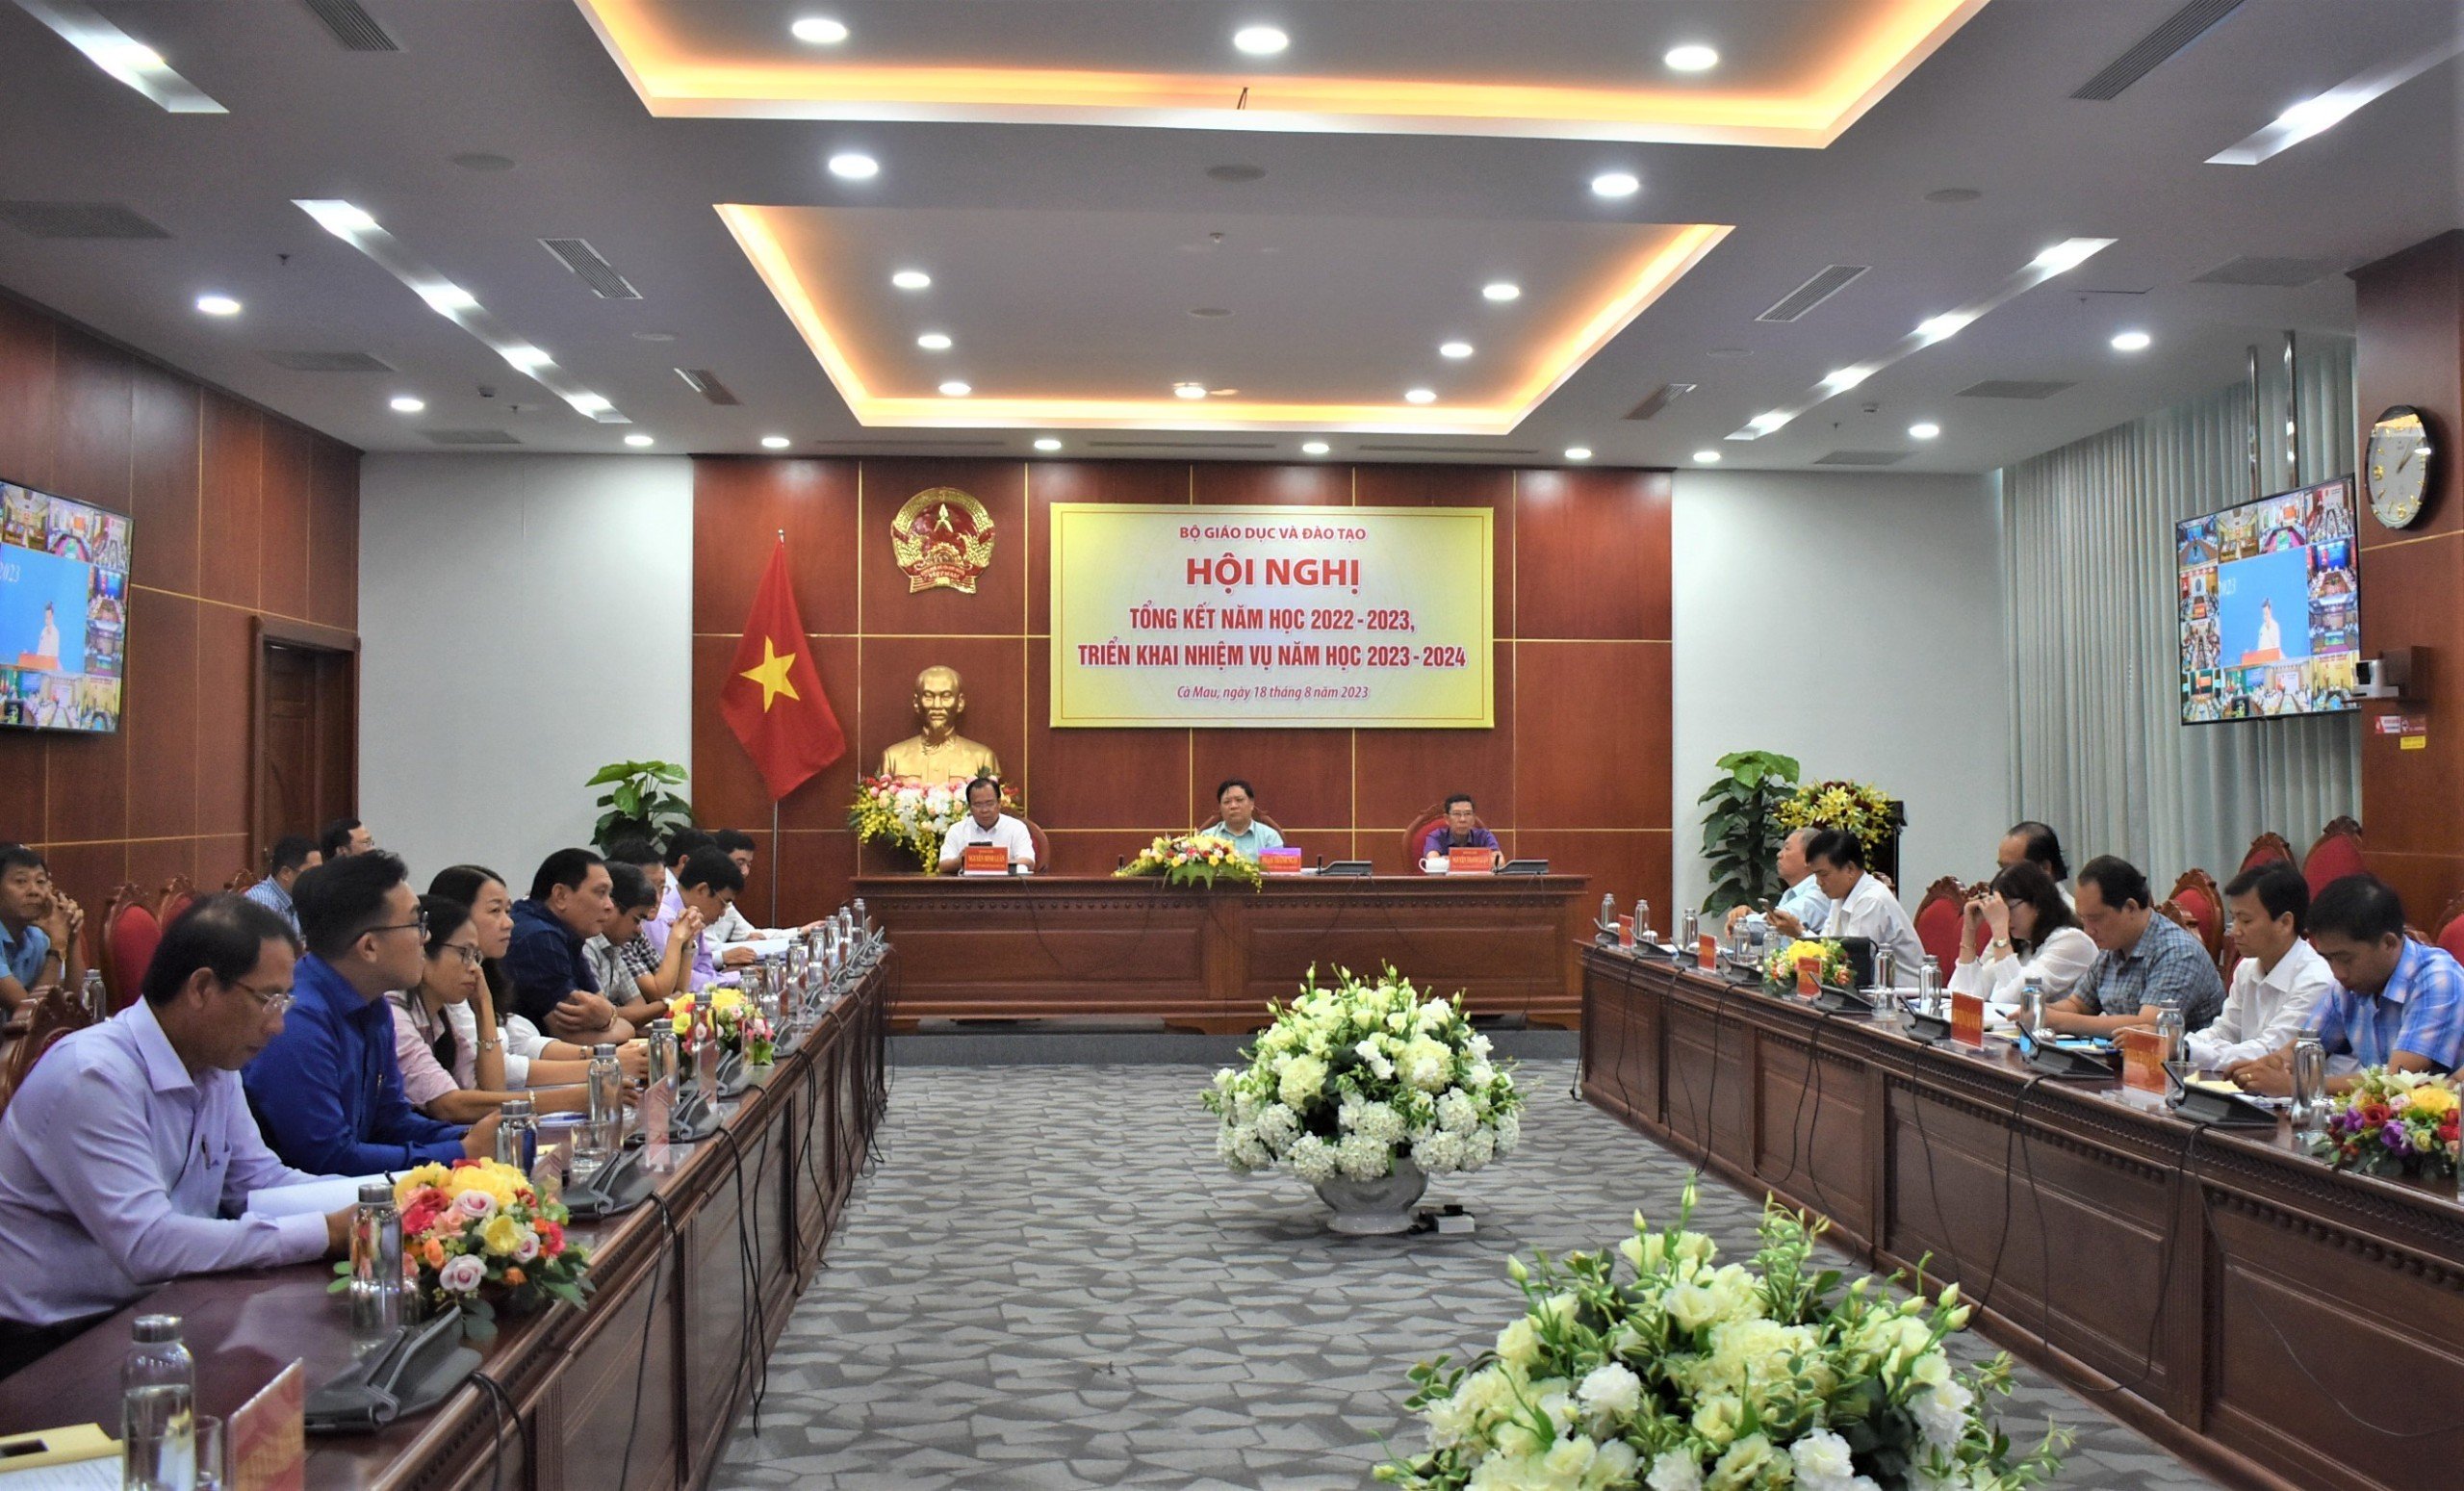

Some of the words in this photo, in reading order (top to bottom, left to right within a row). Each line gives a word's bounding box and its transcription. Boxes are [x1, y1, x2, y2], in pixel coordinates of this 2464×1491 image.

[1179, 525, 1201, 542] BỘ
[1204, 525, 1242, 539] GIÁO
[1245, 527, 1275, 543] DỤC
[1279, 525, 1298, 539] VÀ
[1302, 526, 1334, 540] ĐÀO
[1337, 528, 1366, 543] TẠO
[1187, 552, 1253, 595] HỘI
[1266, 558, 1359, 595] NGHỊ
[1130, 600, 1177, 630] TỔNG
[1183, 602, 1216, 630] KẾT
[1221, 604, 1263, 630] NĂM
[1269, 608, 1305, 634] HỌC
[1311, 609, 1354, 630] 2022
[1078, 635, 1130, 666] TRIỂN
[1136, 645, 1178, 666] KHAI
[1185, 641, 1244, 671] NHIỆM
[1249, 645, 1272, 671] VỤ
[1278, 641, 1320, 666] NĂM
[1326, 645, 1362, 671] HỌC
[1367, 646, 1410, 666] 2023
[1423, 646, 1466, 667] 2024
[1177, 685, 1190, 698] Cà
[1193, 686, 1219, 700] Mau,
[1222, 685, 1251, 701] ngày
[1254, 686, 1267, 699] 18
[1270, 685, 1301, 701] tháng
[1304, 685, 1311, 699] 8
[1313, 686, 1338, 699] năm
[1341, 686, 1369, 699] 2023
